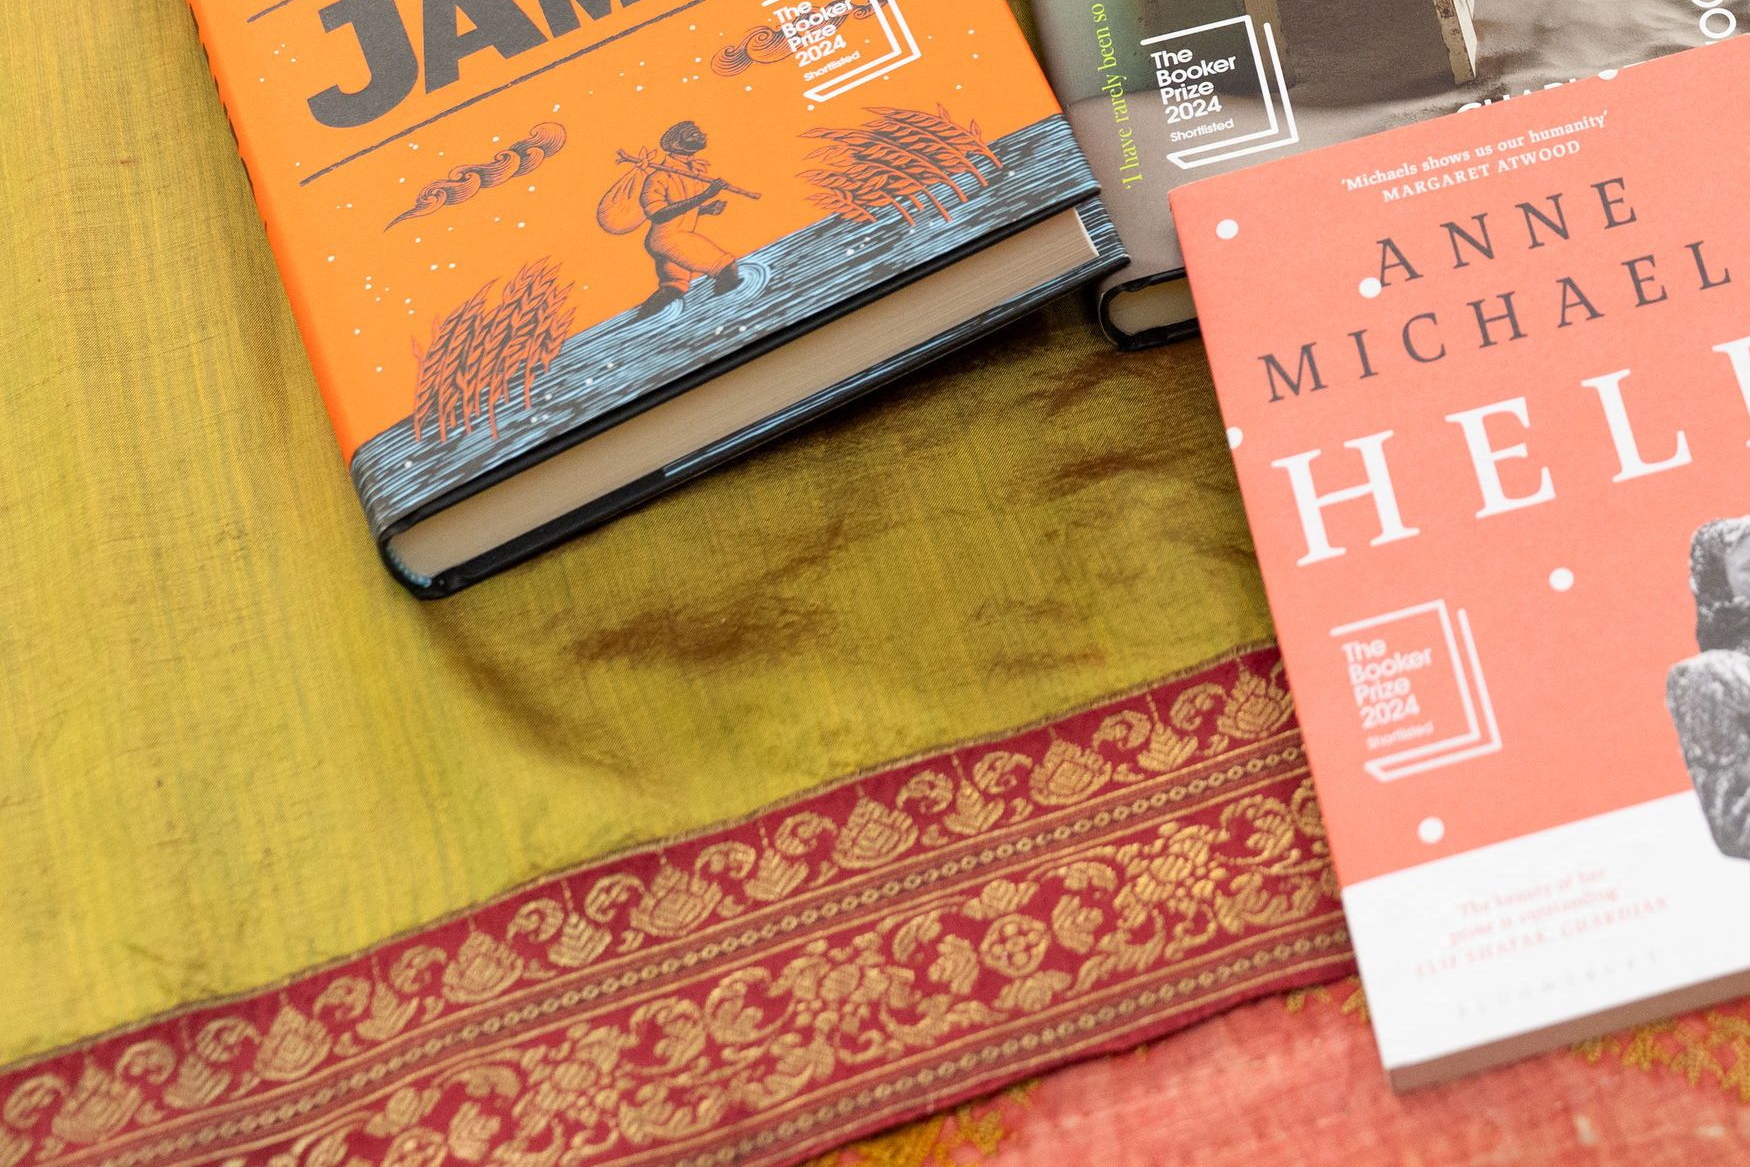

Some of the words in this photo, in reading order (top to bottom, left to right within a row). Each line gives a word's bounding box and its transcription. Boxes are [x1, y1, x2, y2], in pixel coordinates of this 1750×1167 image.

[773, 1, 812, 24] The
[1091, 3, 1107, 23] so
[788, 23, 837, 52] Prize
[795, 34, 847, 67] 2024
[1097, 26, 1117, 71] been
[803, 50, 861, 81] Shortlisted
[1150, 48, 1193, 69] The
[1156, 55, 1237, 87] Booker
[1102, 74, 1130, 123] rarely
[1160, 81, 1215, 105] Prize
[1165, 95, 1222, 124] 2024
[1170, 118, 1235, 142] Shortlisted
[1119, 127, 1140, 171] have
[1421, 149, 1471, 172] shows
[1475, 144, 1493, 158] us
[1497, 136, 1525, 152] our
[1382, 163, 1491, 202] MARGARET
[1497, 139, 1581, 173] ATWOOD
[1373, 176, 1638, 288] ANNE
[1341, 639, 1387, 663] The
[1349, 647, 1432, 685] Booker
[1354, 677, 1411, 706] Prize
[1360, 693, 1420, 730] 2024
